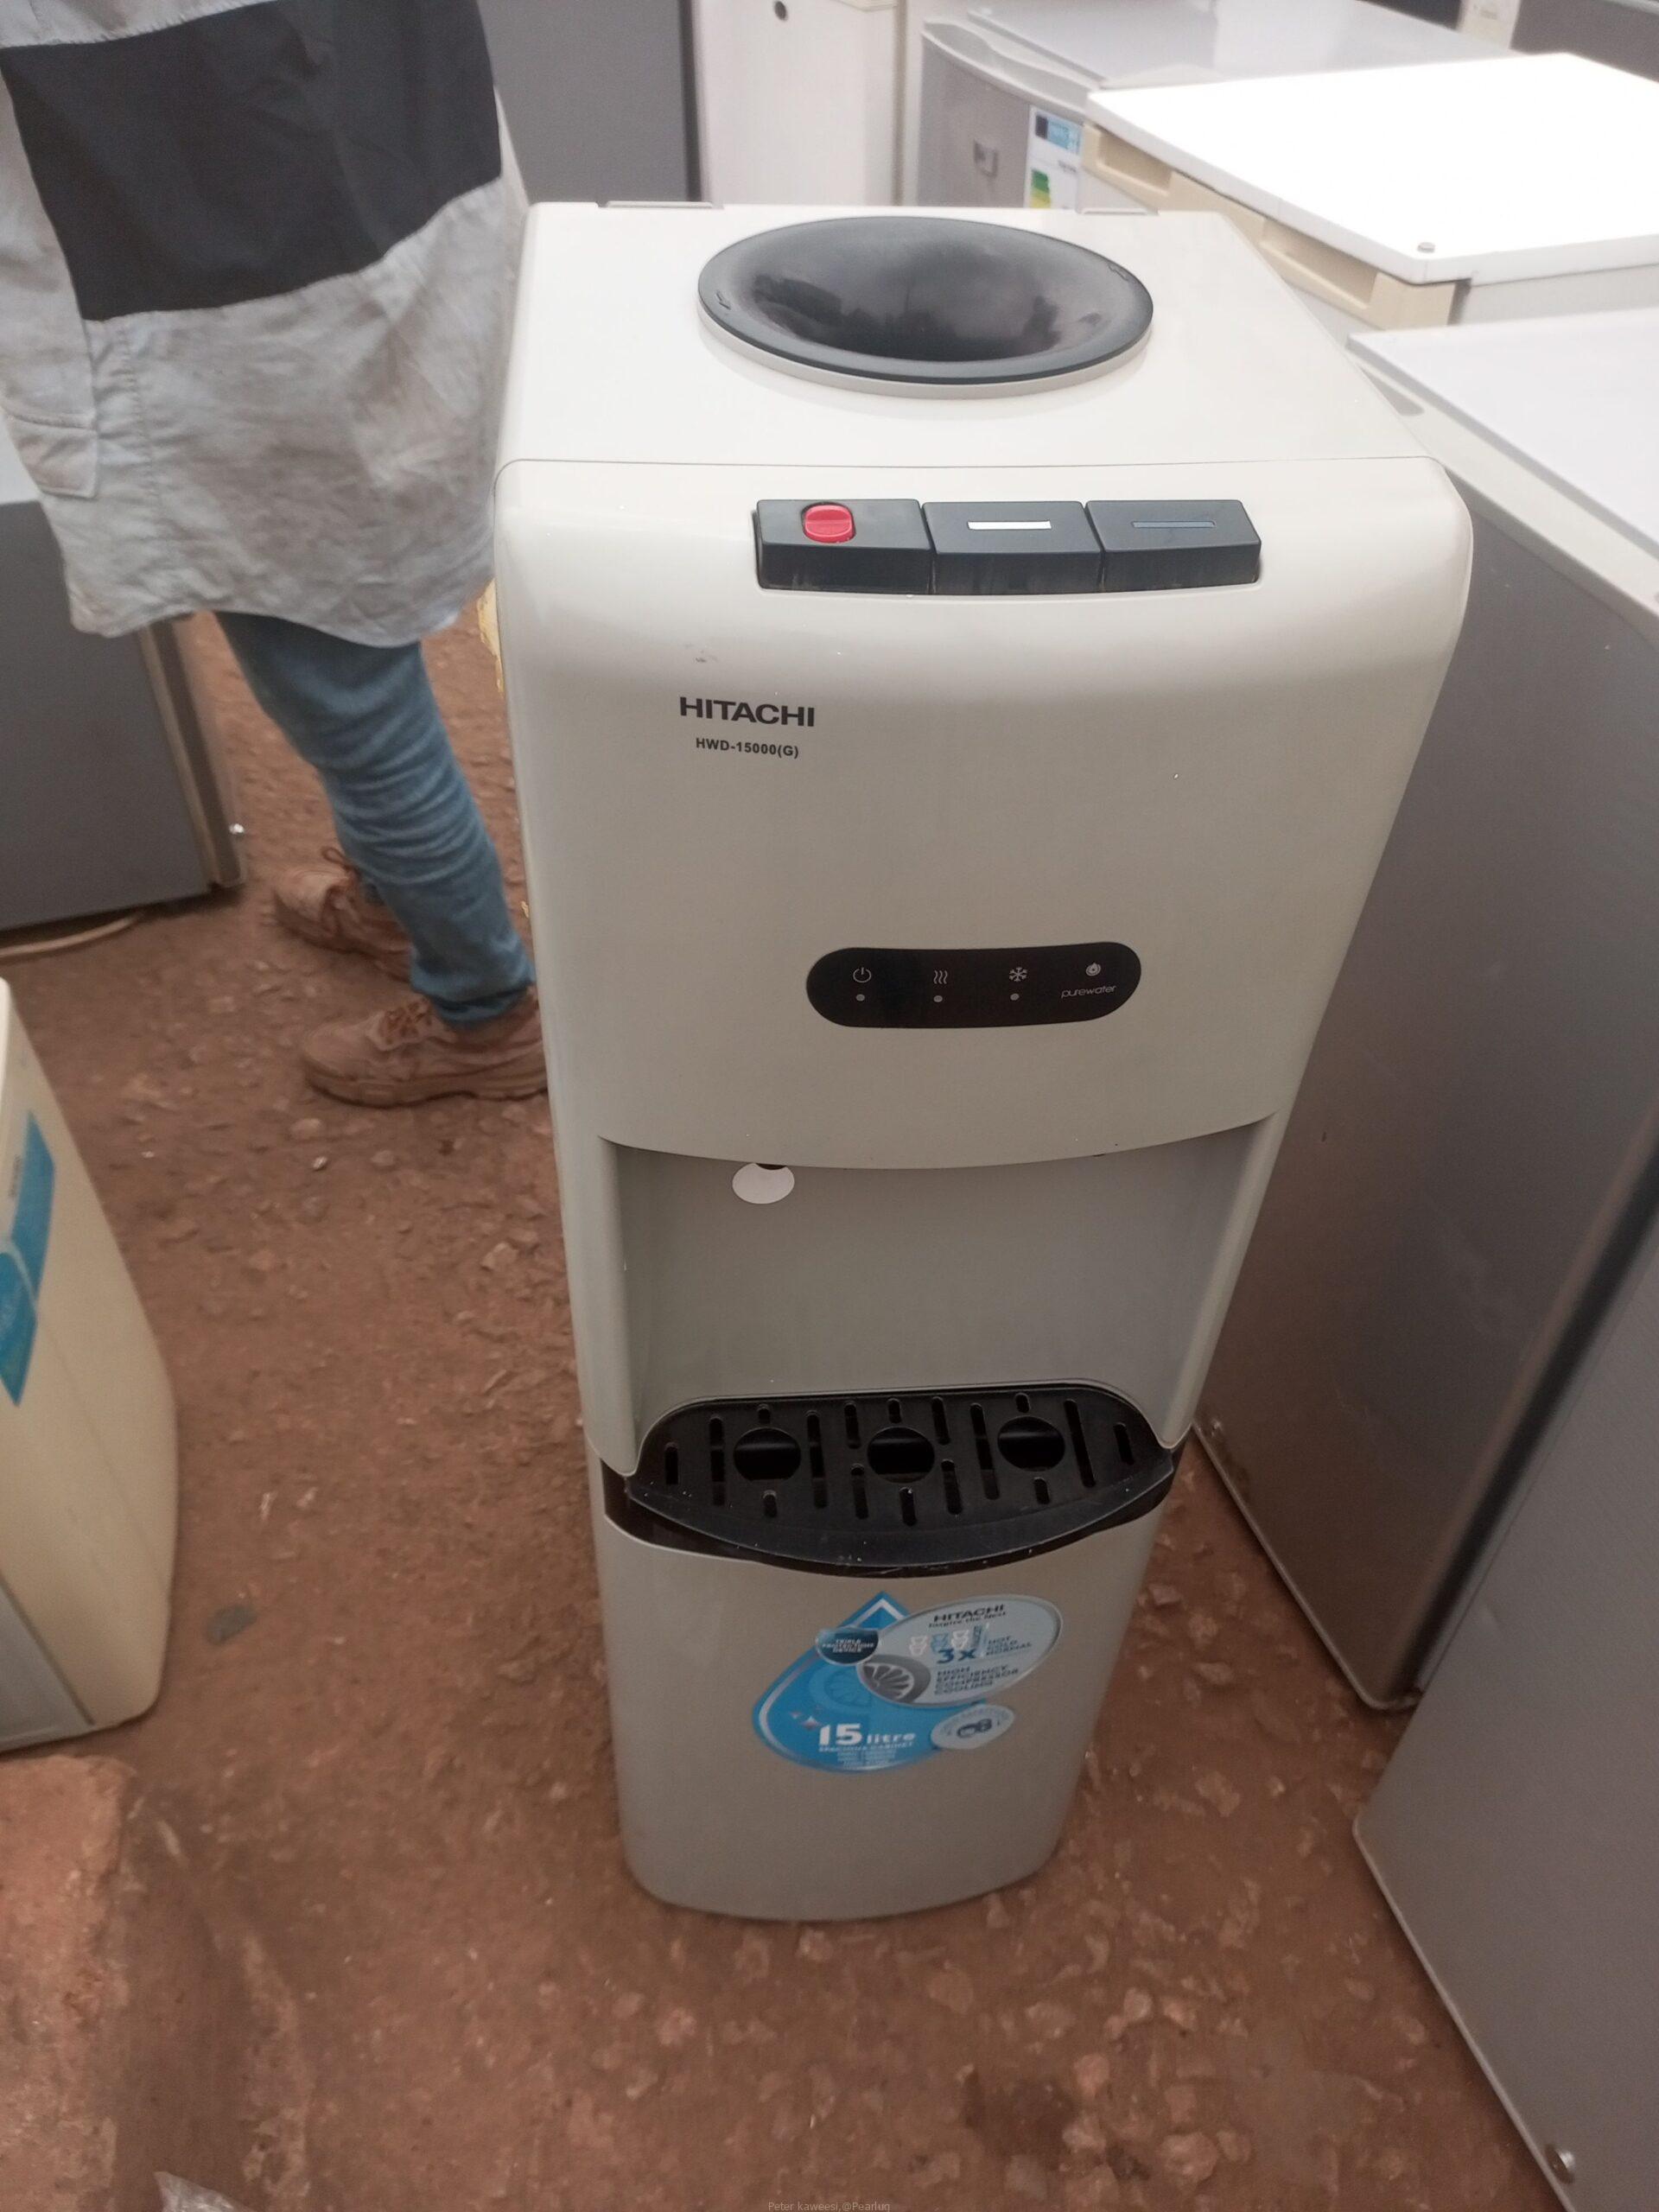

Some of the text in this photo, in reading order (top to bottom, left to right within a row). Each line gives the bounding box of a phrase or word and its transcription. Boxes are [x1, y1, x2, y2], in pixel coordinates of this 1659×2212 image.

[680, 696, 815, 727] HITACHI
[696, 737, 799, 760] HWD-15000(G)
[1061, 985, 1116, 999] purewater
[933, 1604, 1005, 1623] HITACHI
[818, 1724, 917, 1746] 15 litre
